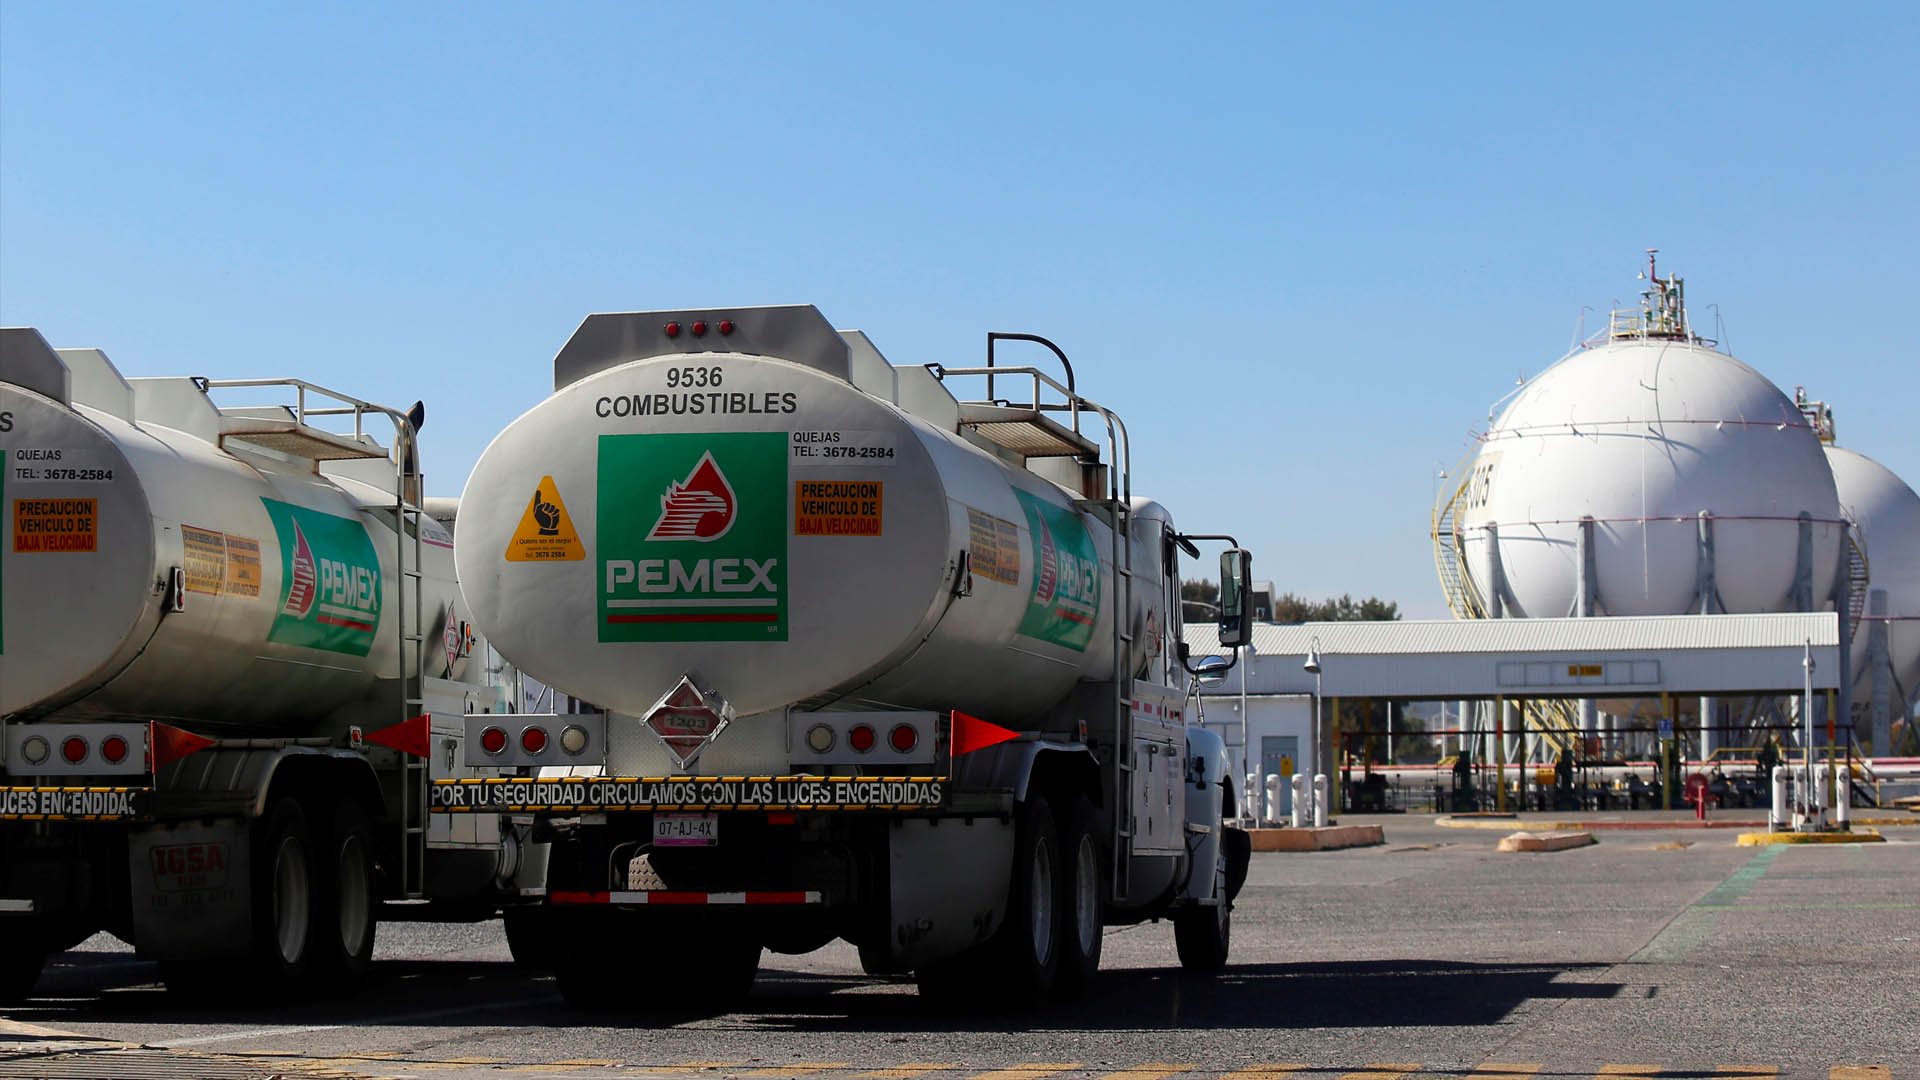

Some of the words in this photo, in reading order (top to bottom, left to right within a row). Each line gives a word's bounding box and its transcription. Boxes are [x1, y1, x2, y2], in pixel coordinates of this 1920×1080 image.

[666, 366, 723, 388] 9536
[595, 392, 797, 418] COMBUSTIBLES
[793, 432, 840, 443] QUEJAS
[16, 449, 62, 461] QUEJAS
[793, 446, 818, 457] TEL:
[823, 447, 894, 458] 3678-2584
[16, 468, 40, 479] TEL:
[44, 469, 113, 480] 3678-2584
[802, 484, 878, 498] PRECAUCION
[19, 501, 92, 516] PRECAUCION
[802, 501, 858, 515] VEHICULO
[862, 501, 877, 515] DE
[20, 518, 74, 533] VEHICULO
[77, 518, 92, 532] DE
[799, 518, 824, 534] BAJA
[826, 518, 879, 534] VELOCIDAD
[16, 535, 41, 551] BAJA
[43, 534, 94, 551] VELOCIDAD
[606, 558, 778, 593] PEMEX
[1060, 550, 1098, 604] PEMEX
[320, 558, 378, 611] PEMEX
[431, 784, 465, 806] POR
[468, 784, 489, 805] TU
[493, 784, 585, 806] SEGURIDAD
[589, 783, 696, 805] CIRCULAMOS
[701, 782, 737, 804] CON
[741, 782, 773, 804] LAS
[778, 782, 831, 804] LUCES
[835, 782, 942, 805] ENCENDIDAS
[659, 821, 712, 836] 07-AJ-4X
